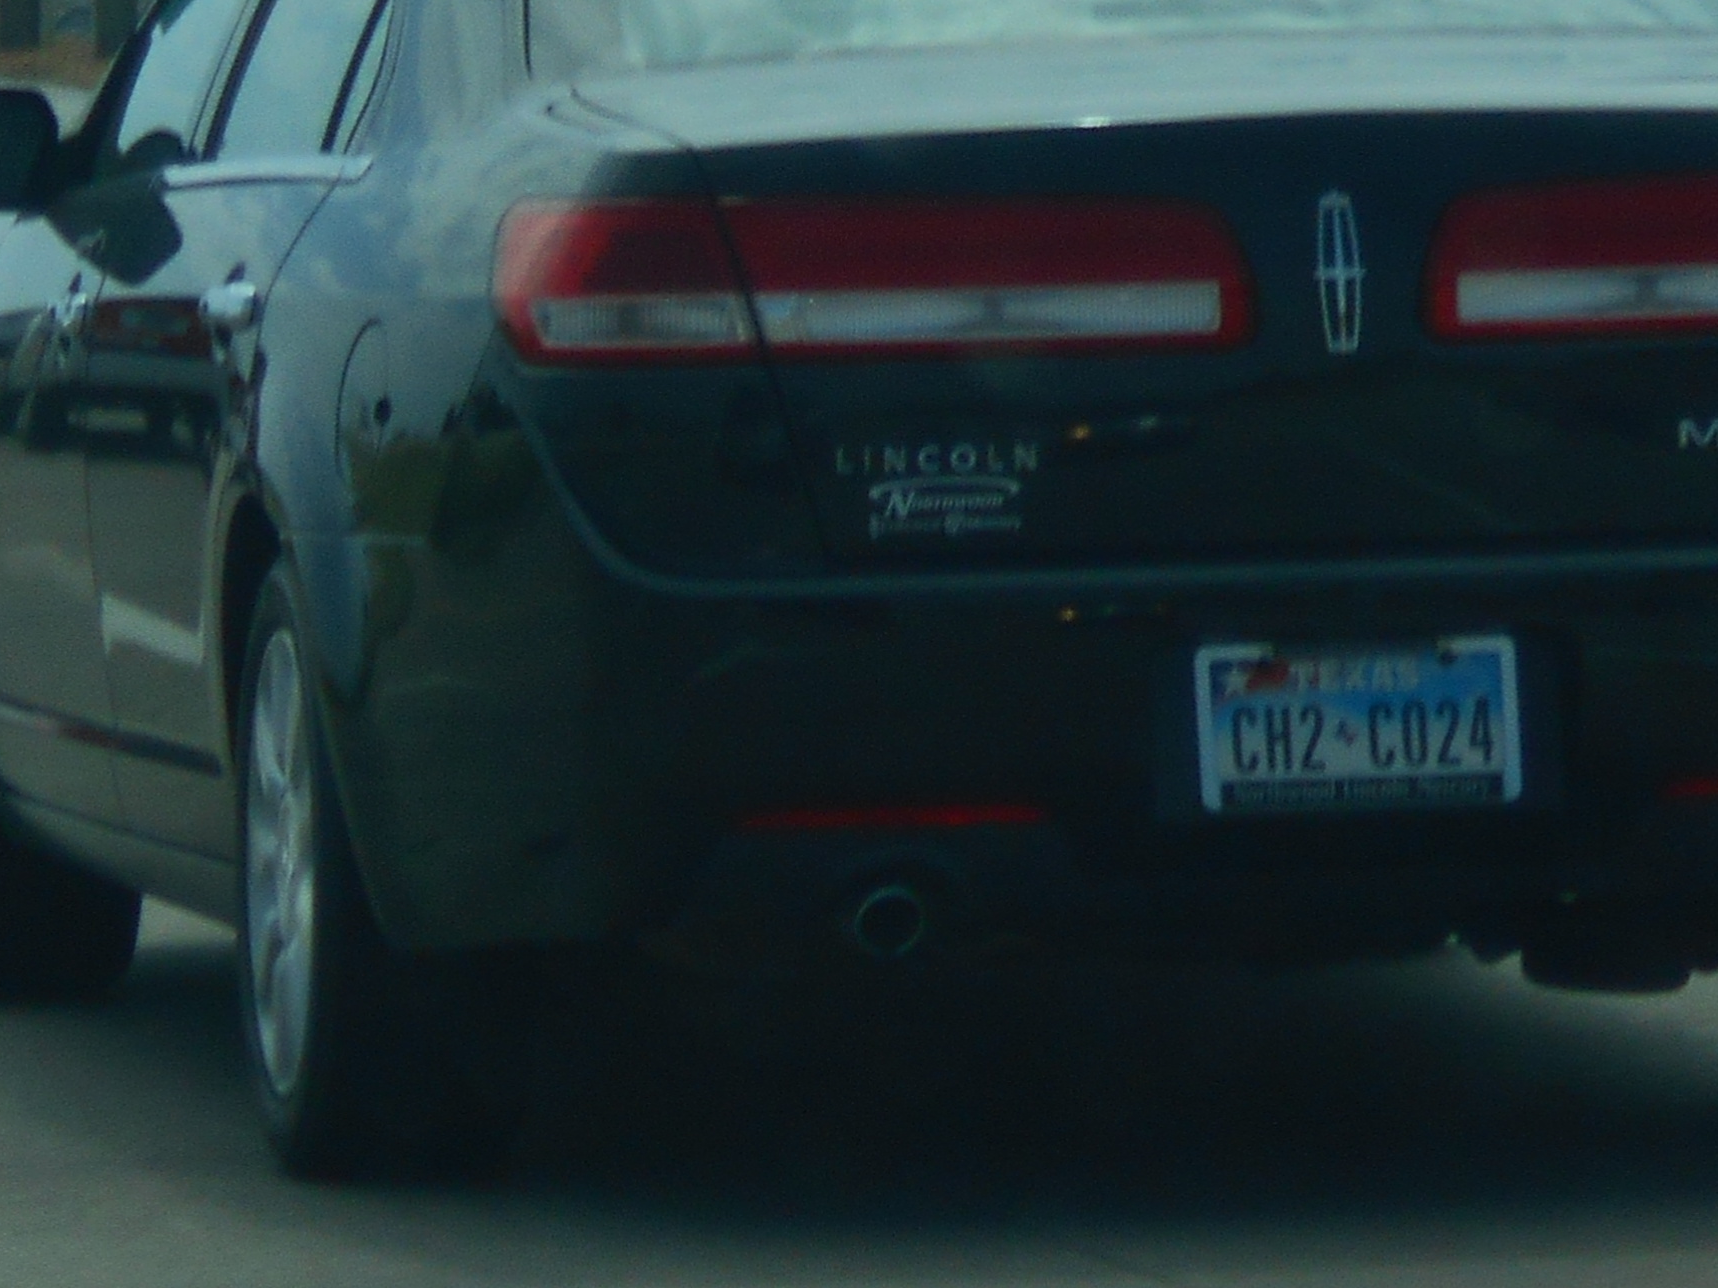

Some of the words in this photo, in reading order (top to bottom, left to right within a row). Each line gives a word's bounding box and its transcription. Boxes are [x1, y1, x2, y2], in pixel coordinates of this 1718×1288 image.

[835, 439, 1040, 475] LINCOLN
[1289, 655, 1420, 692] TEXAS
[1231, 705, 1327, 772] CH2
